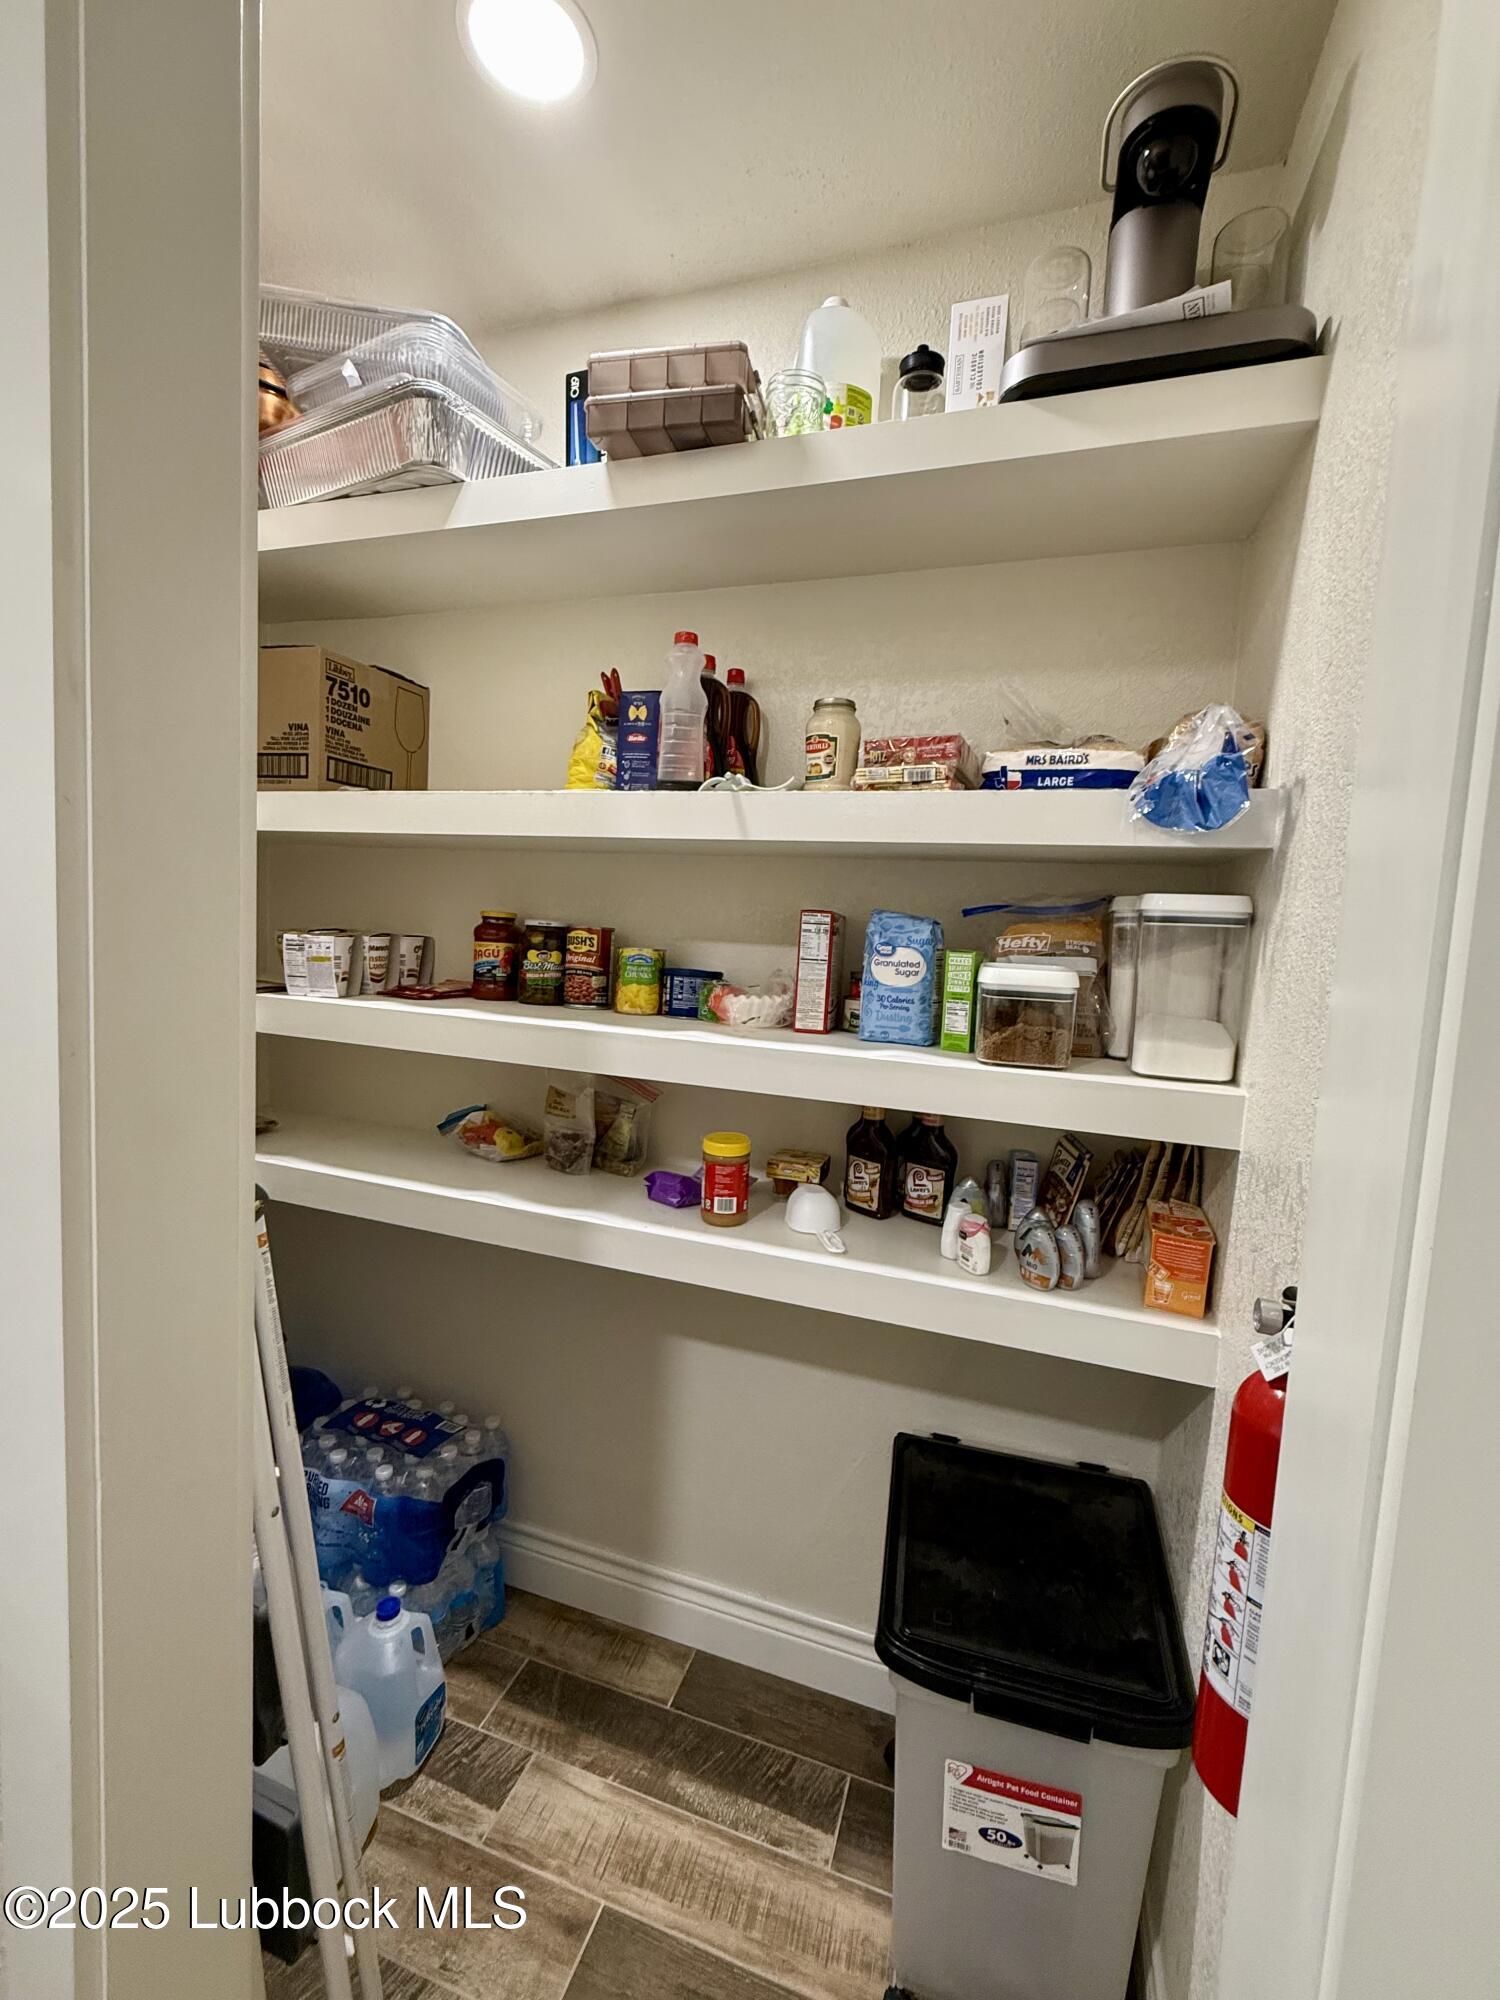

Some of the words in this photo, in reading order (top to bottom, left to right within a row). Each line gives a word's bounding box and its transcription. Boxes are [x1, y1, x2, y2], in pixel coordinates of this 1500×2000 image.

[970, 352, 978, 381] CLASSIC
[976, 349, 985, 391] COLLECTION
[325, 674, 371, 709] 7510
[330, 697, 359, 713] DOZEN
[330, 707, 371, 726] DOUZAINE
[288, 723, 310, 731] VINA
[330, 715, 364, 733] DOCENA
[325, 725, 346, 739] VINA
[869, 750, 887, 762] RITZ
[1026, 755, 1047, 766] MRS
[1049, 753, 1090, 766] BAIRD'S
[1037, 776, 1075, 788] LARGE
[567, 935, 596, 948] BUSH'S
[906, 935, 934, 948] Sugar
[998, 935, 1046, 950] Hefty
[566, 953, 597, 964] Original
[873, 958, 921, 968] Granulated
[894, 969, 921, 978] Sugar
[863, 976, 879, 990] king
[887, 995, 915, 1004] Calories
[976, 1774, 1006, 1789] Airtight
[1006, 1782, 1020, 1793] Pet
[1020, 1786, 1040, 1799] Food
[1040, 1791, 1079, 1808] Container
[985, 1829, 1007, 1843] 50
